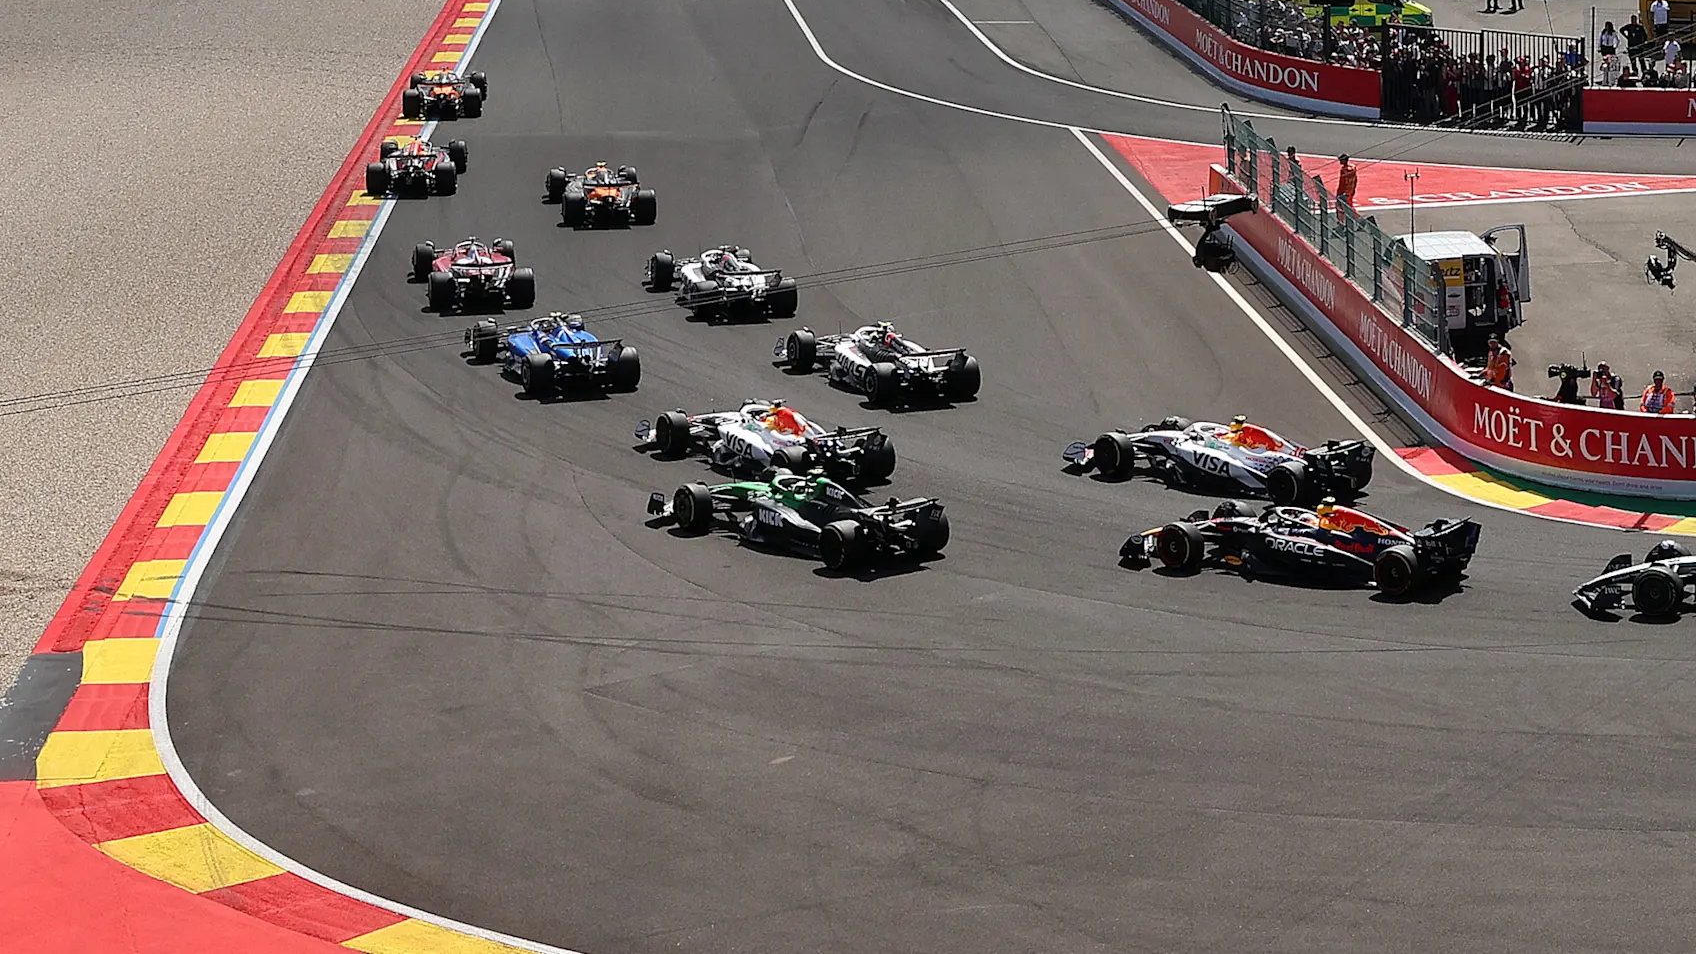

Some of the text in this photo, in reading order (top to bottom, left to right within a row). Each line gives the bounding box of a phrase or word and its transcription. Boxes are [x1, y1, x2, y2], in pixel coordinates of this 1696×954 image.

[1196, 29, 1320, 92] MOËT & CHANDON
[1409, 182, 1651, 203] CHANDON
[1278, 236, 1336, 312] MOËT & CHANDON
[1440, 266, 1461, 277] ertz
[1360, 311, 1432, 400] MOËT & CHANDON
[1472, 402, 1544, 452] MOËT
[1550, 422, 1574, 459] &
[725, 431, 751, 459] VISA
[1193, 450, 1231, 477] VISA
[826, 486, 844, 500] KICK
[758, 508, 784, 528] KICK
[1265, 538, 1324, 557] ORACLE
[1604, 586, 1620, 594] IWC
